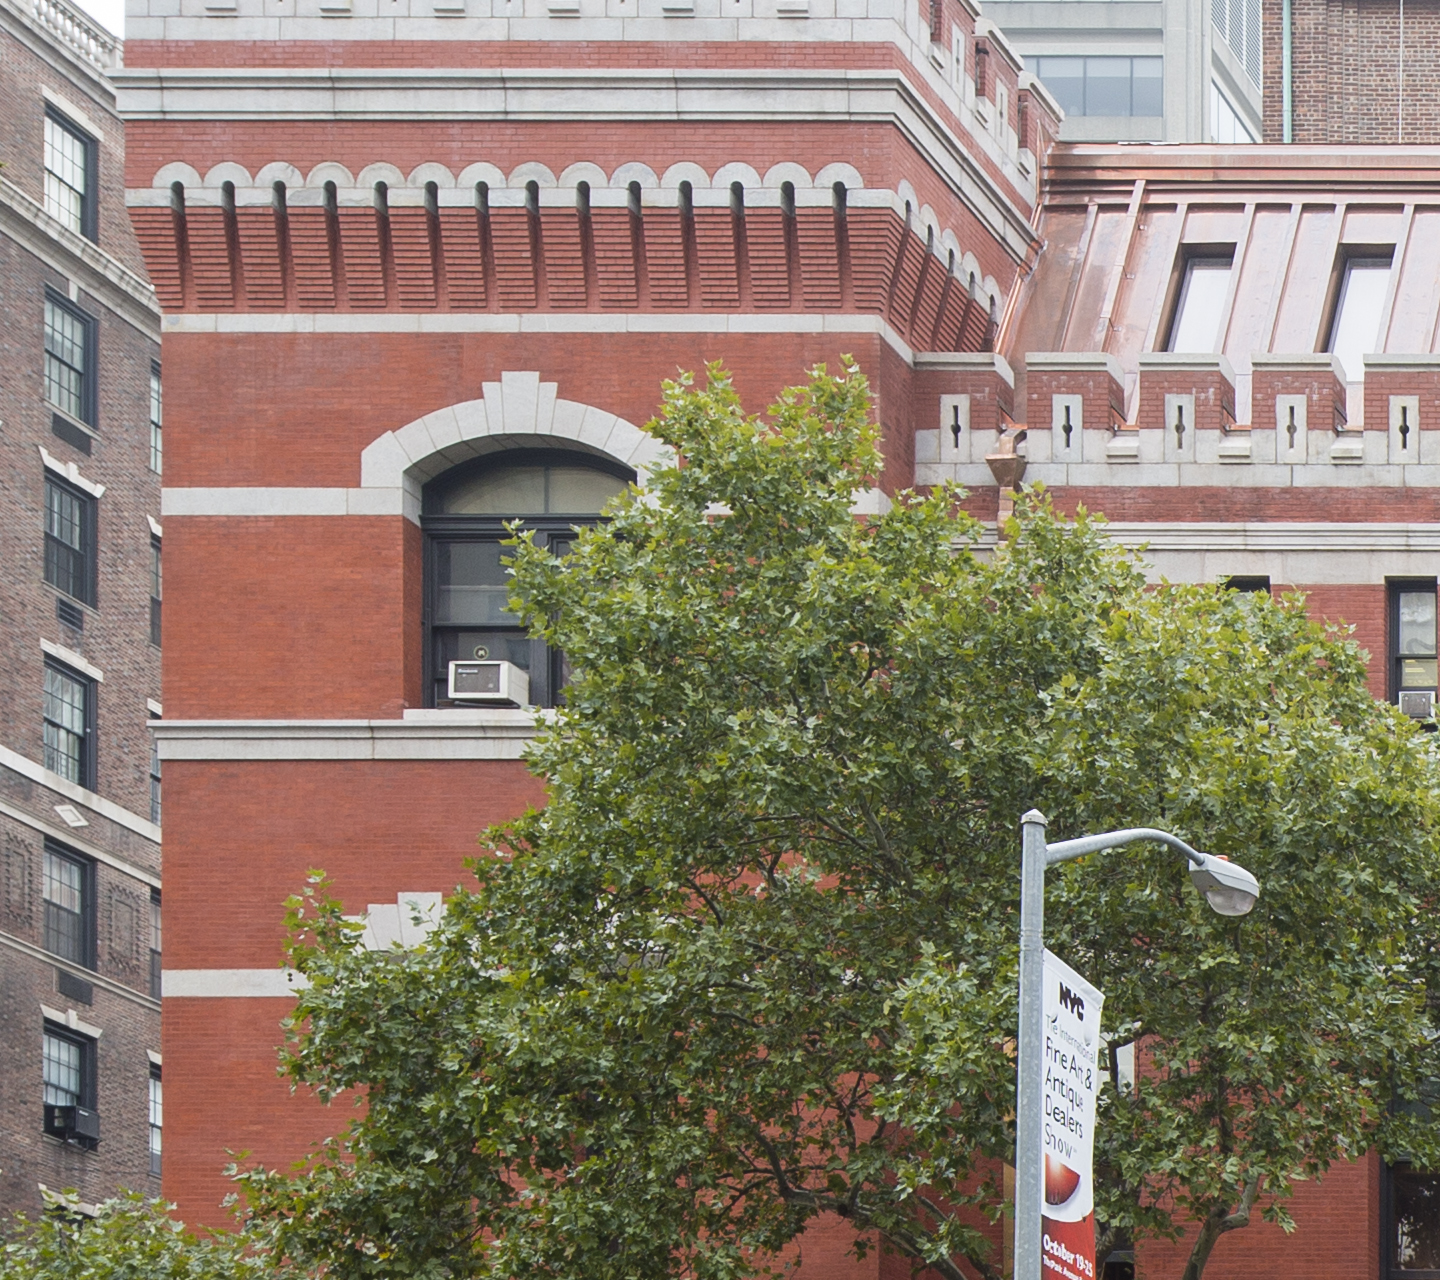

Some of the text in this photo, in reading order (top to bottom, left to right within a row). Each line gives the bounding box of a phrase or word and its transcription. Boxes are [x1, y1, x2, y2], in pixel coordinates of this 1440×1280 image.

[1059, 981, 1085, 1021] NYC
[1046, 1035, 1092, 1091] Fine Art &
[1060, 1023, 1096, 1065] International
[1045, 1065, 1083, 1112] Antique
[1045, 1093, 1083, 1139] Dealers
[1043, 1233, 1075, 1265] October
